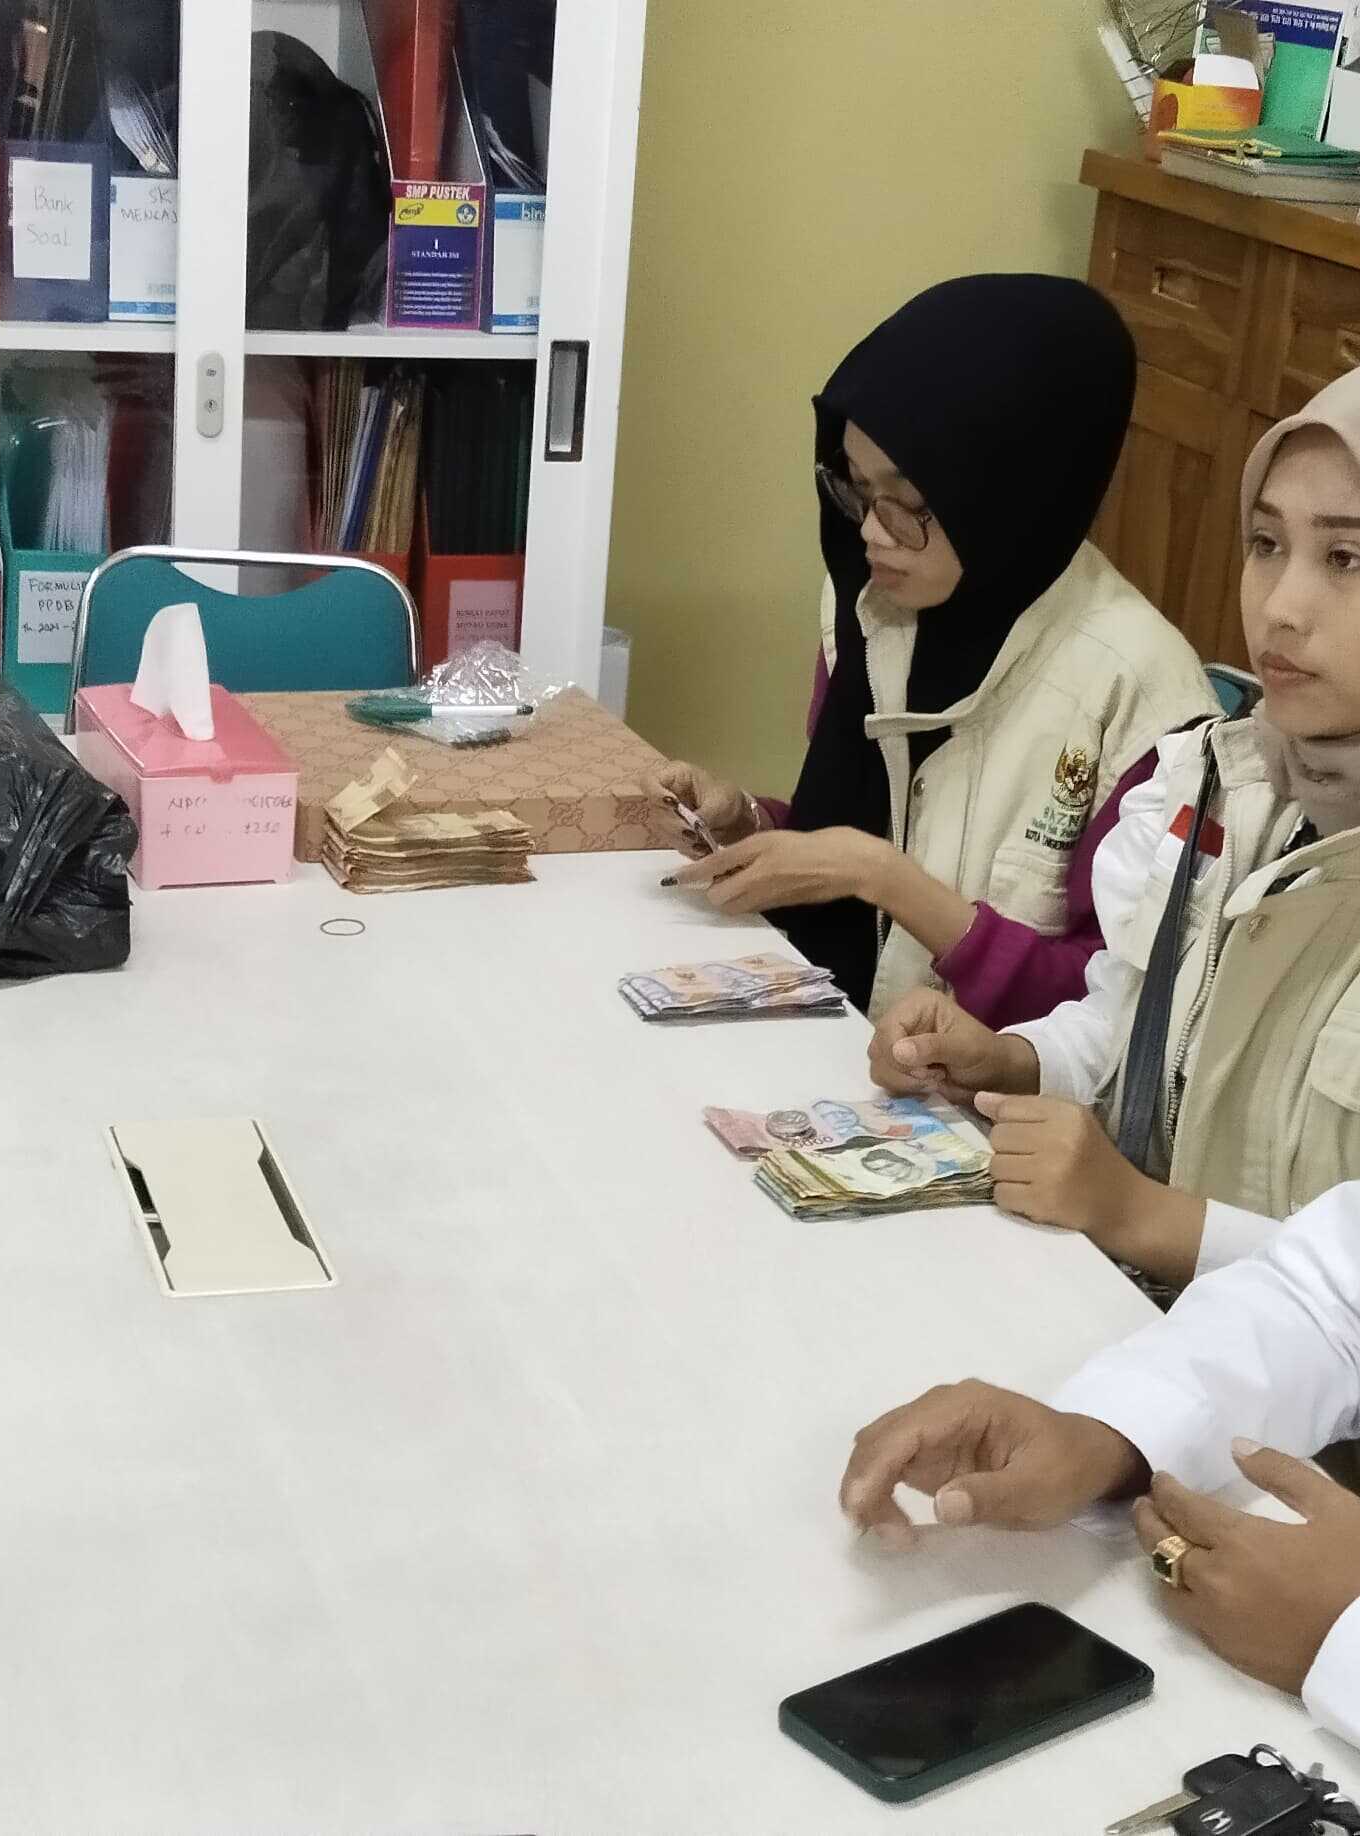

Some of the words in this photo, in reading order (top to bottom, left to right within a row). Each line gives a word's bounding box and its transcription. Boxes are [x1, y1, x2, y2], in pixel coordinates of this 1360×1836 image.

[33, 184, 73, 214] Bank
[406, 185, 428, 199] SMP
[429, 186, 471, 200] PUSTEK
[26, 223, 71, 247] Soal
[1043, 806, 1081, 827] BAZN
